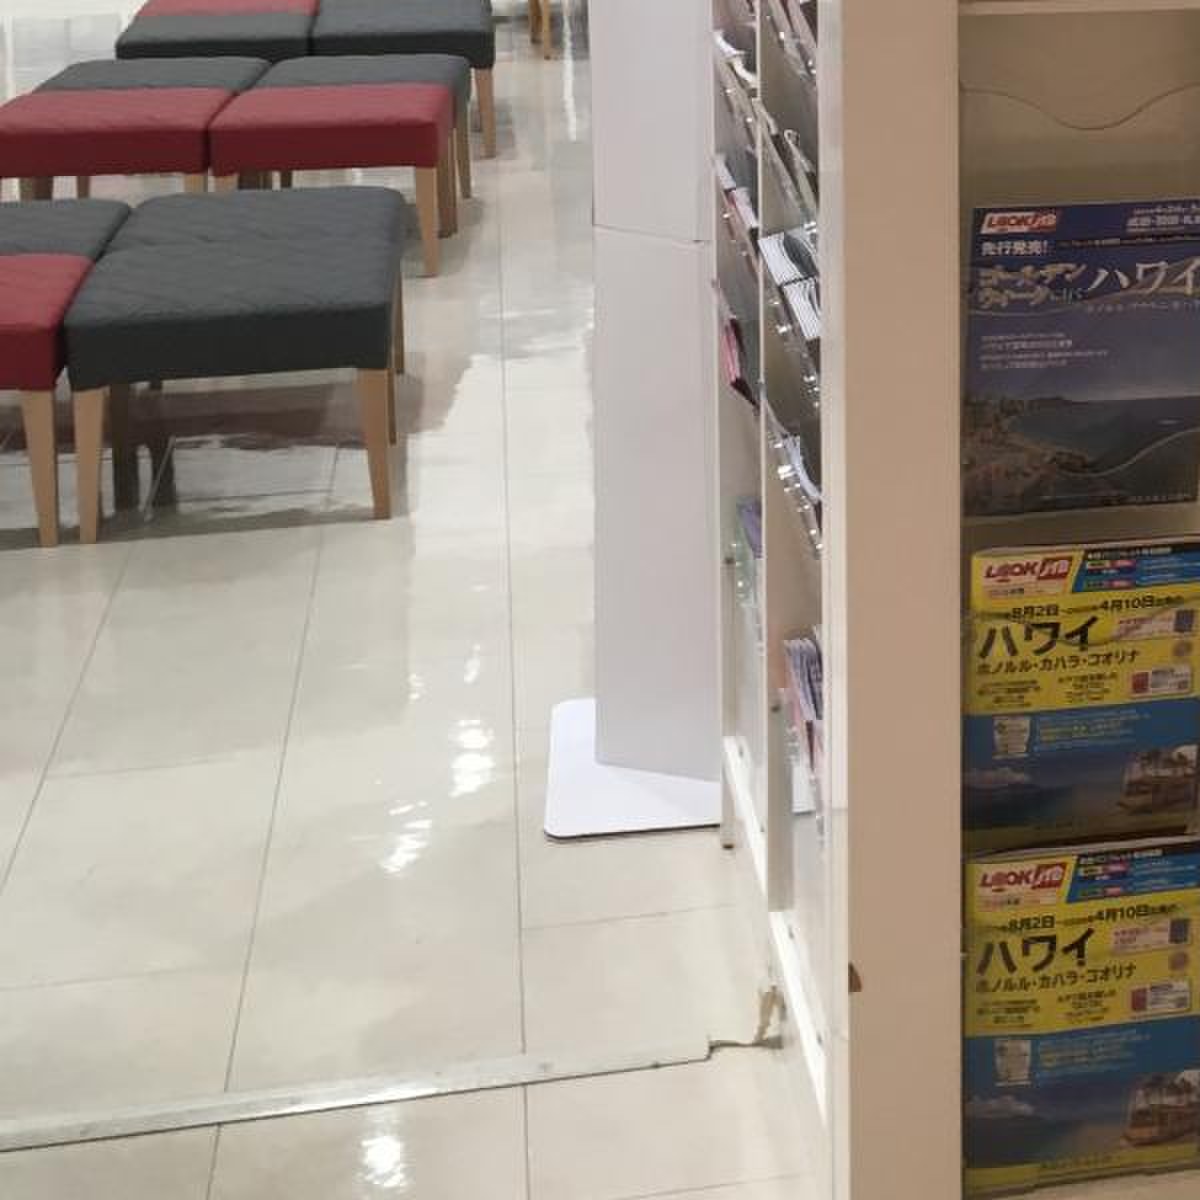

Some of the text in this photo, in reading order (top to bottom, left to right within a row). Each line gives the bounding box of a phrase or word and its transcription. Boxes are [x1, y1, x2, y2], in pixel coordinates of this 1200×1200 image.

[979, 616, 1098, 659] ハワイ
[976, 928, 1095, 975] ハワイ
